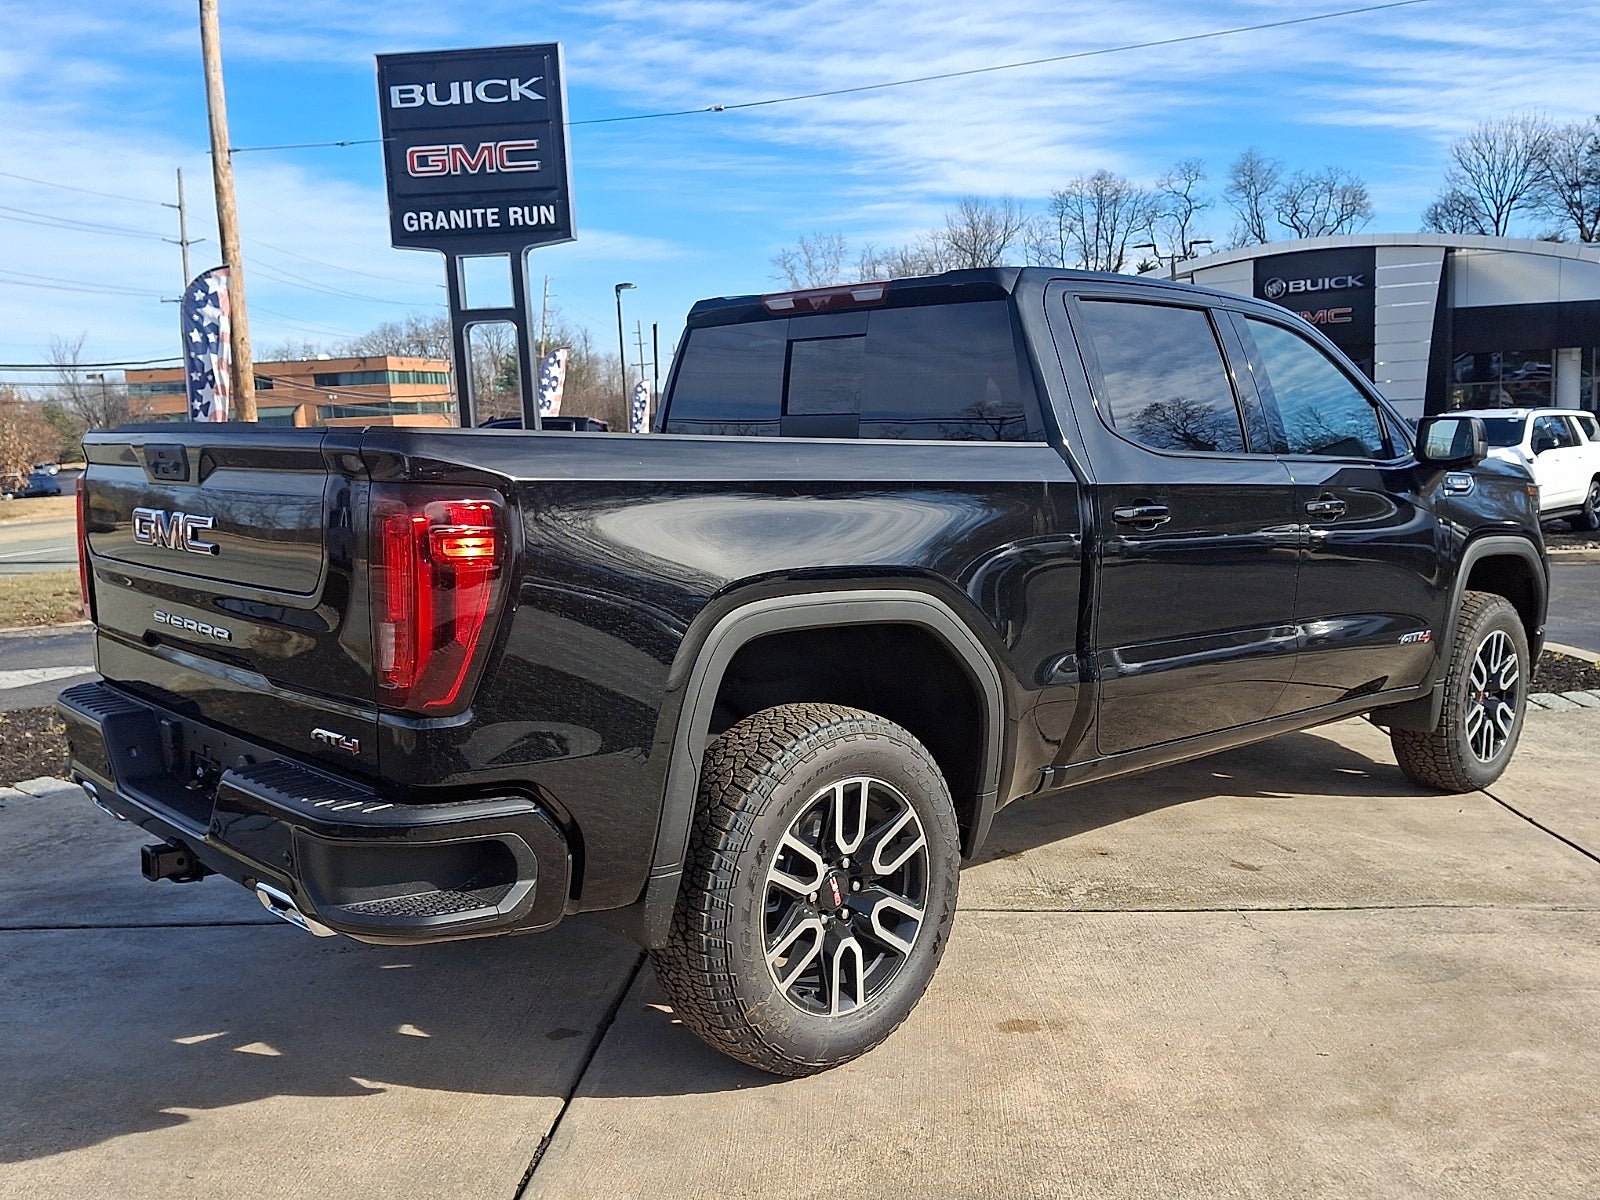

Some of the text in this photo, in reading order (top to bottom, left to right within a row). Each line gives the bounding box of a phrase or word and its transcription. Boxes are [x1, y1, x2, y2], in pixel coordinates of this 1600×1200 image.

[389, 76, 546, 109] BUICK
[406, 139, 541, 178] GMC
[403, 205, 556, 232] GRANITE RUN
[1288, 275, 1365, 293] BUICK
[1296, 307, 1353, 325] MC
[132, 507, 219, 556] GMC
[153, 609, 232, 643] SIERRA
[310, 727, 360, 756] AT4
